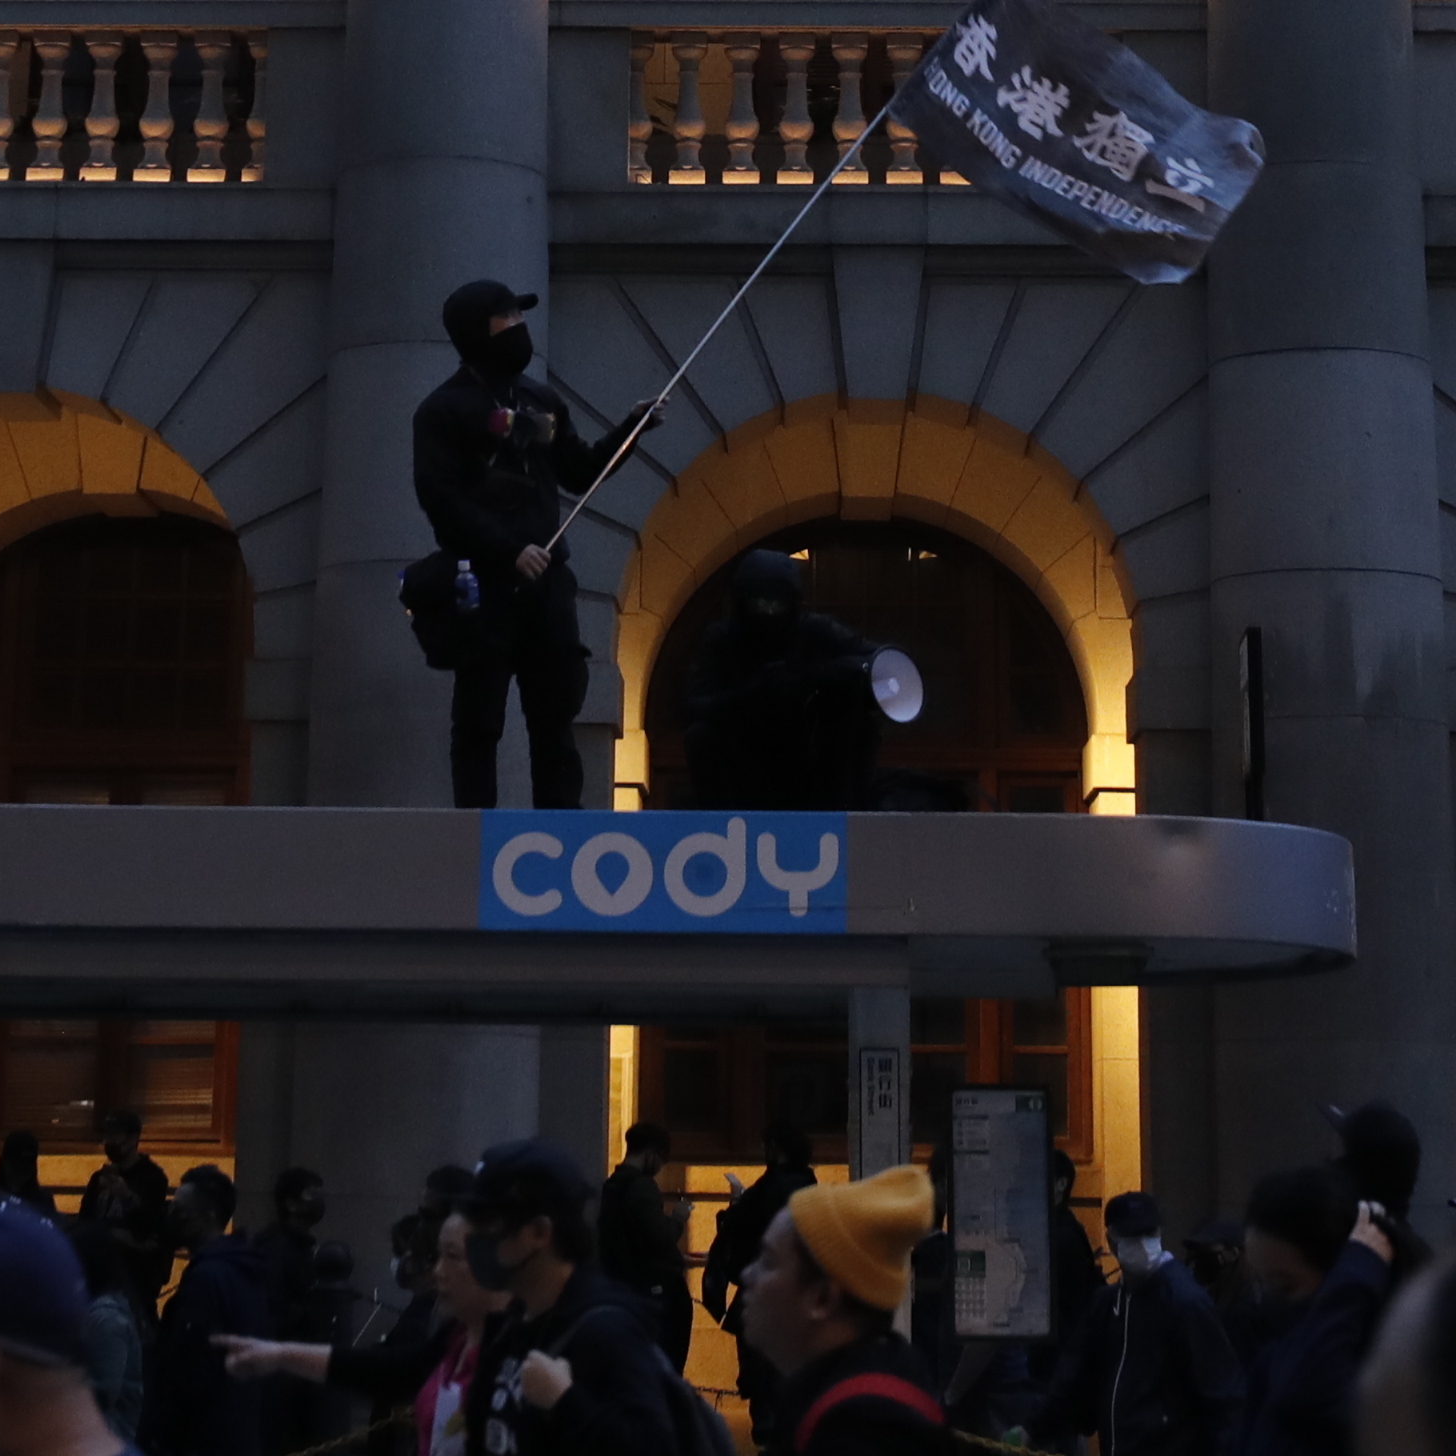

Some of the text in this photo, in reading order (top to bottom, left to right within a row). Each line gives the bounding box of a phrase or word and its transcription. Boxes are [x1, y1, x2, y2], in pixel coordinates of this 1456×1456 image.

[923, 55, 971, 119] HONG
[965, 107, 1023, 169] KONG
[954, 12, 1215, 213] 香港獨立
[492, 816, 840, 918] cody
